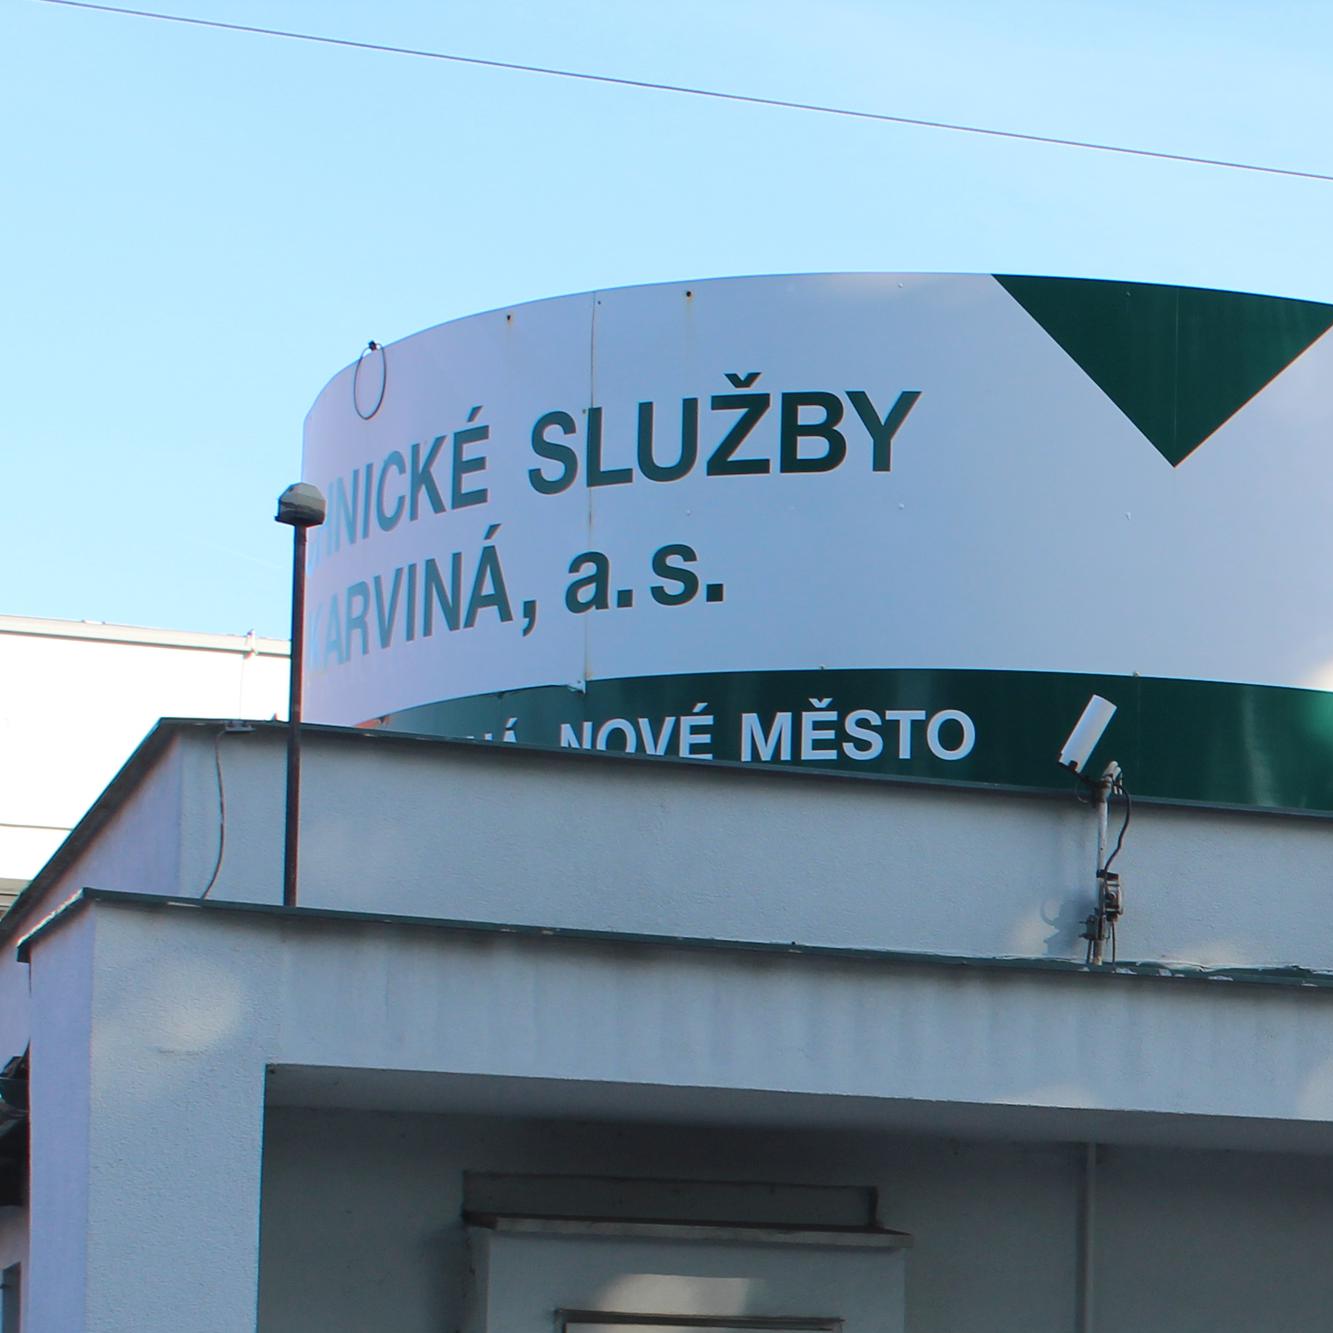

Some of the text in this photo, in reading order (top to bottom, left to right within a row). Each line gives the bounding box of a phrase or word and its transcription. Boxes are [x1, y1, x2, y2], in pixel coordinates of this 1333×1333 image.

[527, 371, 922, 496] SLUŽBY
[559, 703, 715, 760] NOVÉ
[740, 698, 977, 762] MĚSTO
